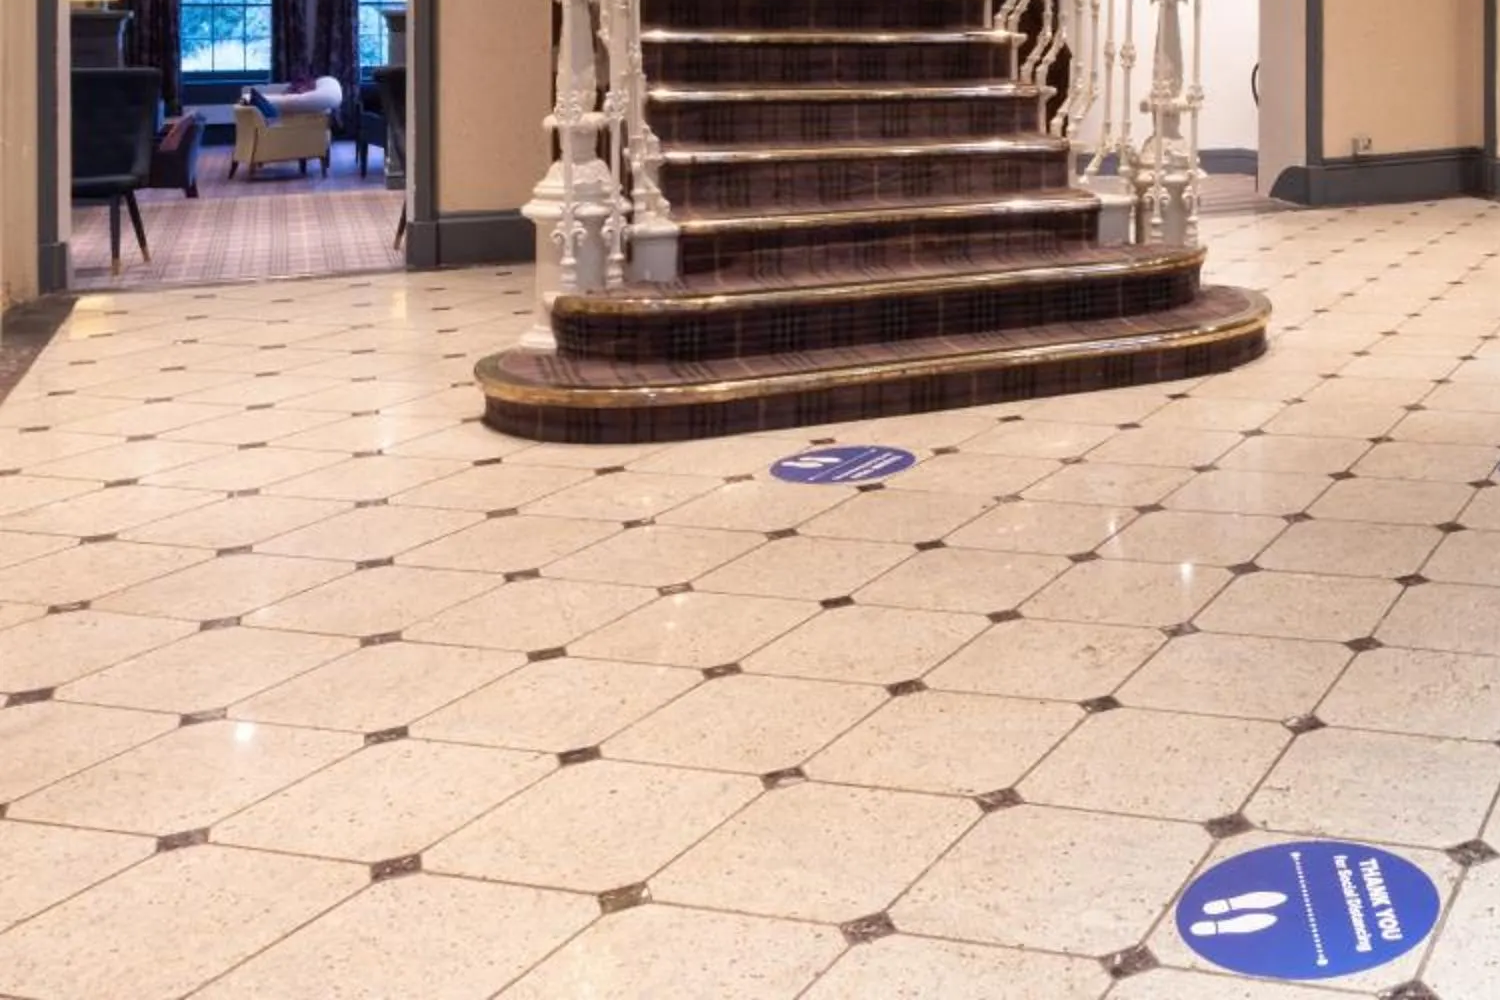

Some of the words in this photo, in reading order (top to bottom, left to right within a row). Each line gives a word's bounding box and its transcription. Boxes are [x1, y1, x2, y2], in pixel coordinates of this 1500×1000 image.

[1333, 855, 1348, 868] for
[1338, 869, 1359, 897] Social
[1359, 857, 1392, 908] THANK
[1375, 907, 1403, 940] YOU
